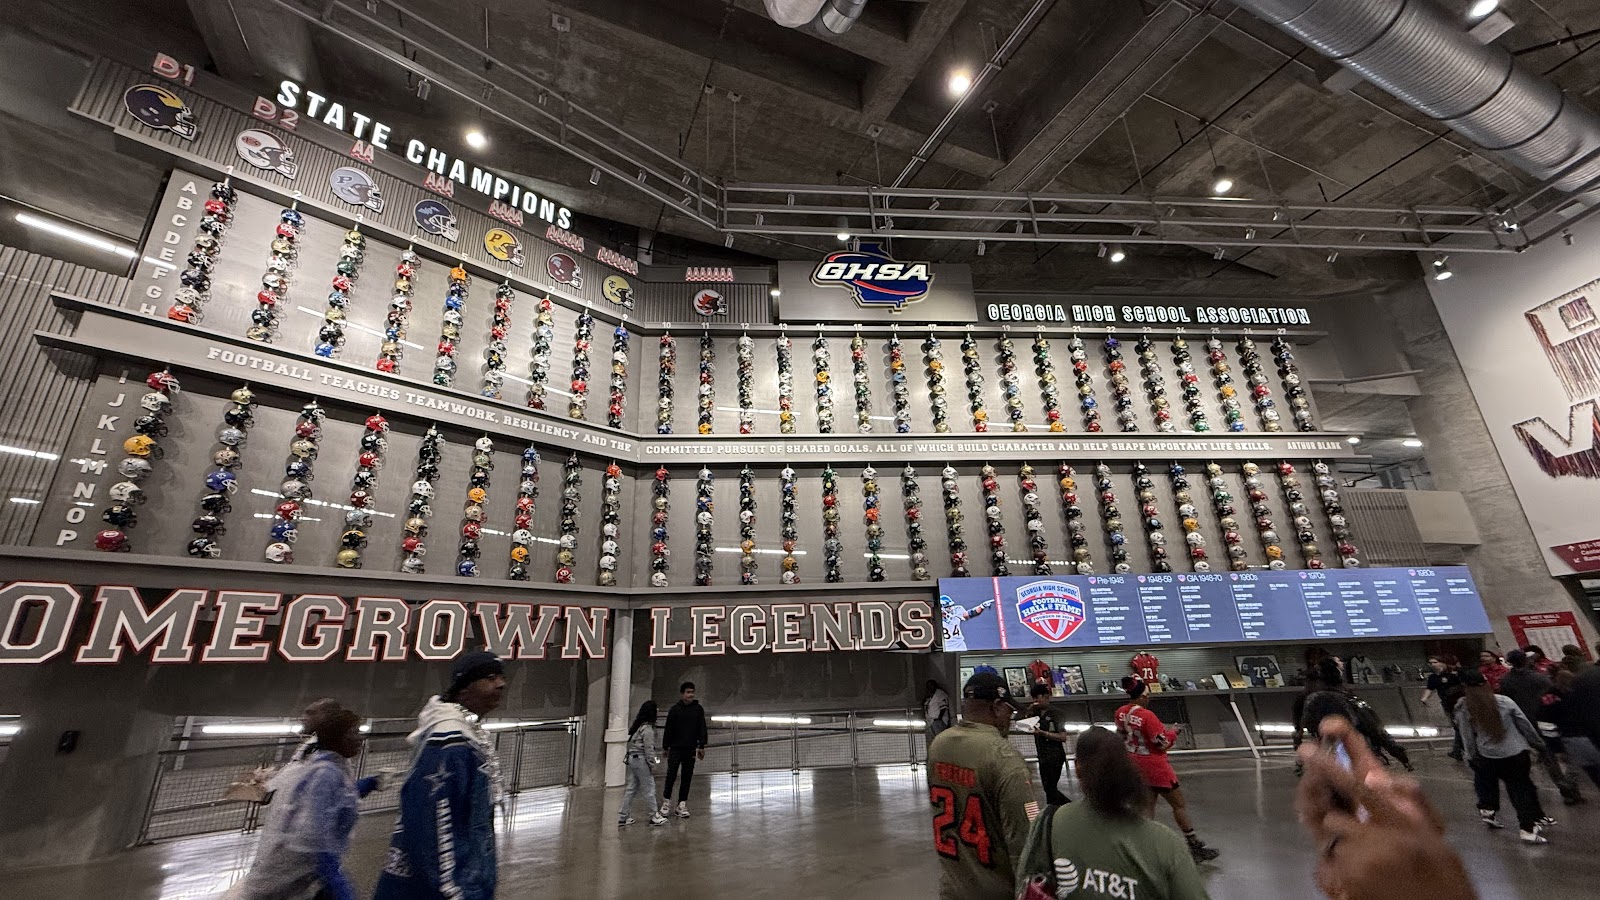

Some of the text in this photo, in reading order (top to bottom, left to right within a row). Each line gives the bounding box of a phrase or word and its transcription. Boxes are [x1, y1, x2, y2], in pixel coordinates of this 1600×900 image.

[152, 52, 195, 86] D1
[252, 95, 299, 130] D2
[276, 80, 572, 230] STATE CHAMPIONS
[350, 139, 374, 164] AA
[181, 181, 197, 195] A
[423, 171, 454, 198] AAA
[177, 196, 193, 210] B
[171, 213, 187, 227] C
[488, 199, 524, 227] AAAA
[164, 230, 181, 245] D
[159, 247, 176, 262] E
[152, 266, 169, 280] F
[816, 262, 930, 281] GHSA
[146, 285, 163, 299] G
[139, 302, 157, 316] H
[987, 303, 1311, 325] GEORGIA HIGH SCHOOL ASSOCIATION
[107, 393, 126, 407] J
[207, 346, 632, 452] FOOTBALL TEACHES TEAMWORK, RESILIENCY AND THE
[97, 414, 120, 431] K
[90, 438, 107, 455] L
[645, 444, 713, 454] COMMITTED
[716, 444, 766, 454] PURSUIT
[769, 444, 784, 454] OF
[786, 444, 830, 454] SHARED
[876, 443, 897, 453] ALL
[900, 443, 913, 453] OF
[916, 442, 954, 453] WHICH
[957, 442, 989, 452] BUILD
[992, 442, 1055, 452] CHARACTER
[1058, 442, 1080, 452] AND
[1083, 442, 1109, 452] HELP
[1112, 442, 1145, 451] SHAPE
[1148, 442, 1208, 451] IMPORTANT
[1210, 441, 1233, 451] LIFE
[1235, 441, 1273, 451] SKILLS.
[1287, 441, 1342, 450] ARTHUR BLANK
[80, 457, 106, 475] M
[73, 482, 96, 499] N
[66, 507, 86, 524] O
[56, 529, 78, 546] P
[1097, 576, 1124, 584] Pre-1948
[1147, 575, 1172, 583] 1948-59
[1020, 586, 1042, 598] GEORGIA
[1057, 585, 1077, 597] SCHOOL
[1031, 597, 1069, 606] FOOTBALL
[1021, 604, 1048, 618] HALL
[1054, 603, 1082, 615] FAME
[0, 581, 609, 664] OMEGROWN
[649, 600, 935, 657] LEGENDS
[1141, 667, 1154, 680] 73
[1253, 666, 1270, 678] 72
[930, 785, 992, 866] 24
[1082, 867, 1139, 900] AT&T
